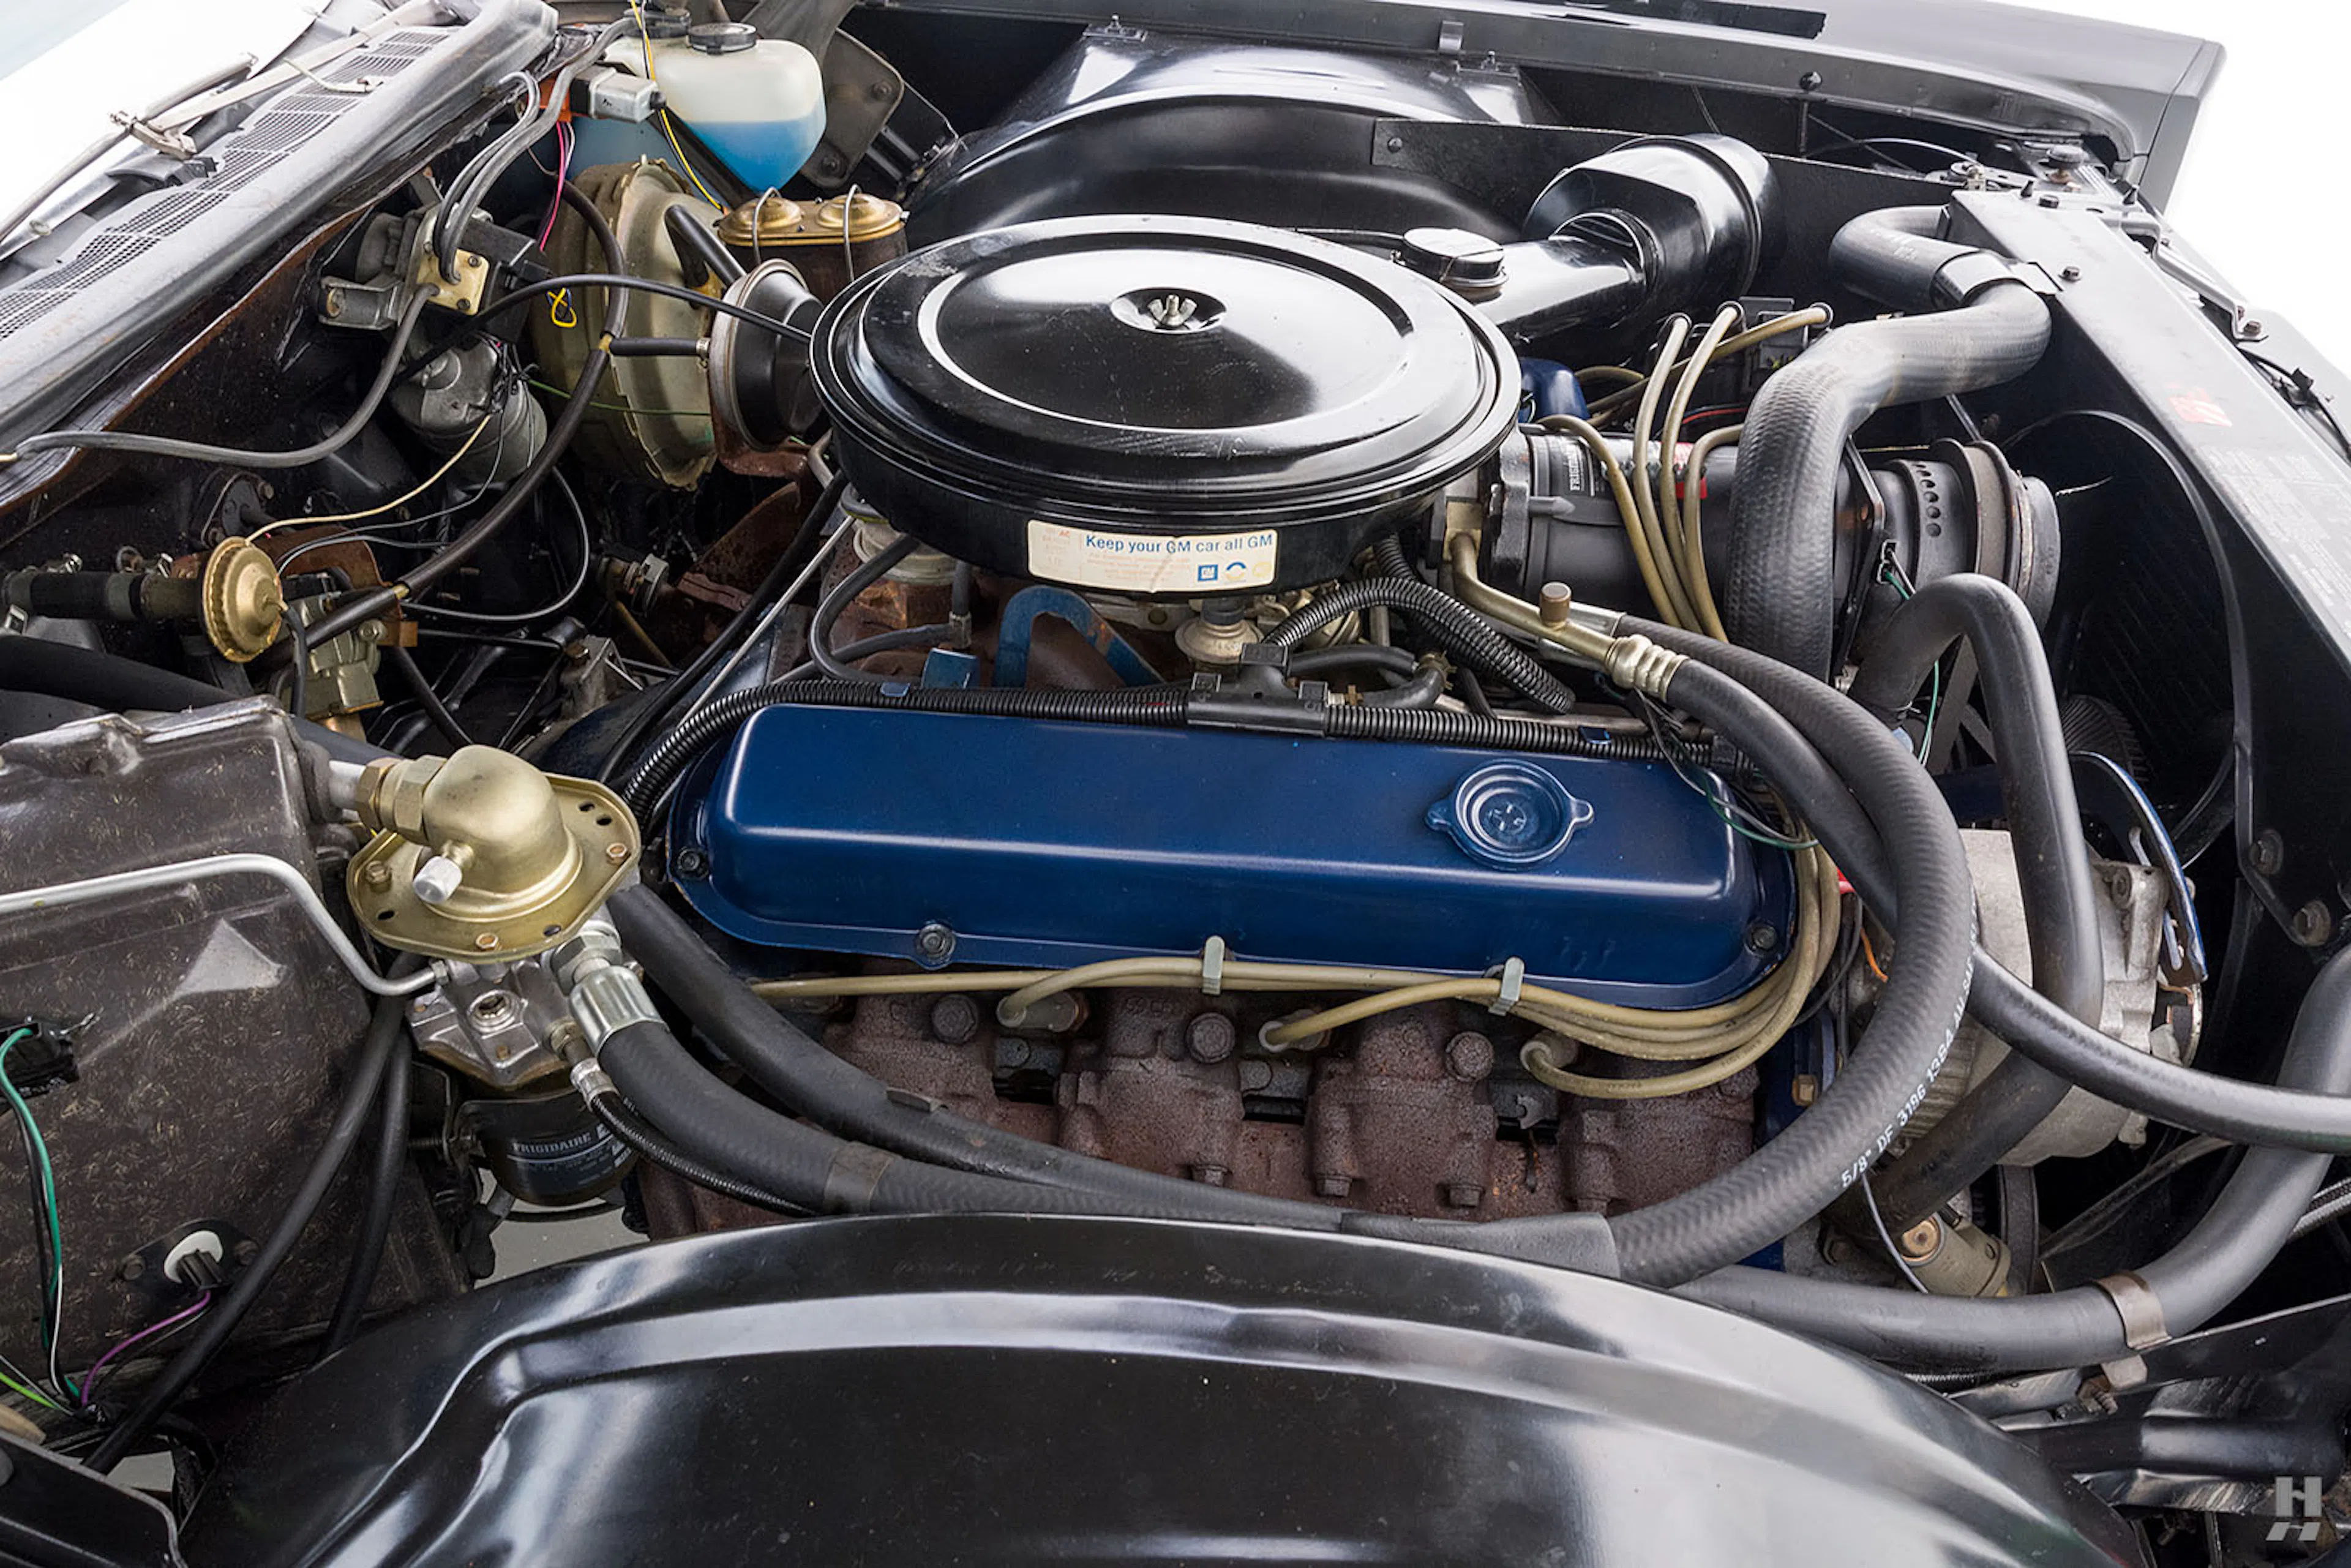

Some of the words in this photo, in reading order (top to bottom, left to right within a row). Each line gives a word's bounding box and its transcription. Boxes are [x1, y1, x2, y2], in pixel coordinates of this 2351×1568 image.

[1086, 535, 1124, 552] Keep
[1128, 542, 1161, 553] your
[1166, 540, 1191, 553] GM
[1196, 541, 1219, 552] car
[1224, 536, 1243, 550] all
[1247, 534, 1273, 549] GM
[512, 1132, 592, 1153] FRIGIDAIRE
[1877, 1124, 1893, 1153] DF
